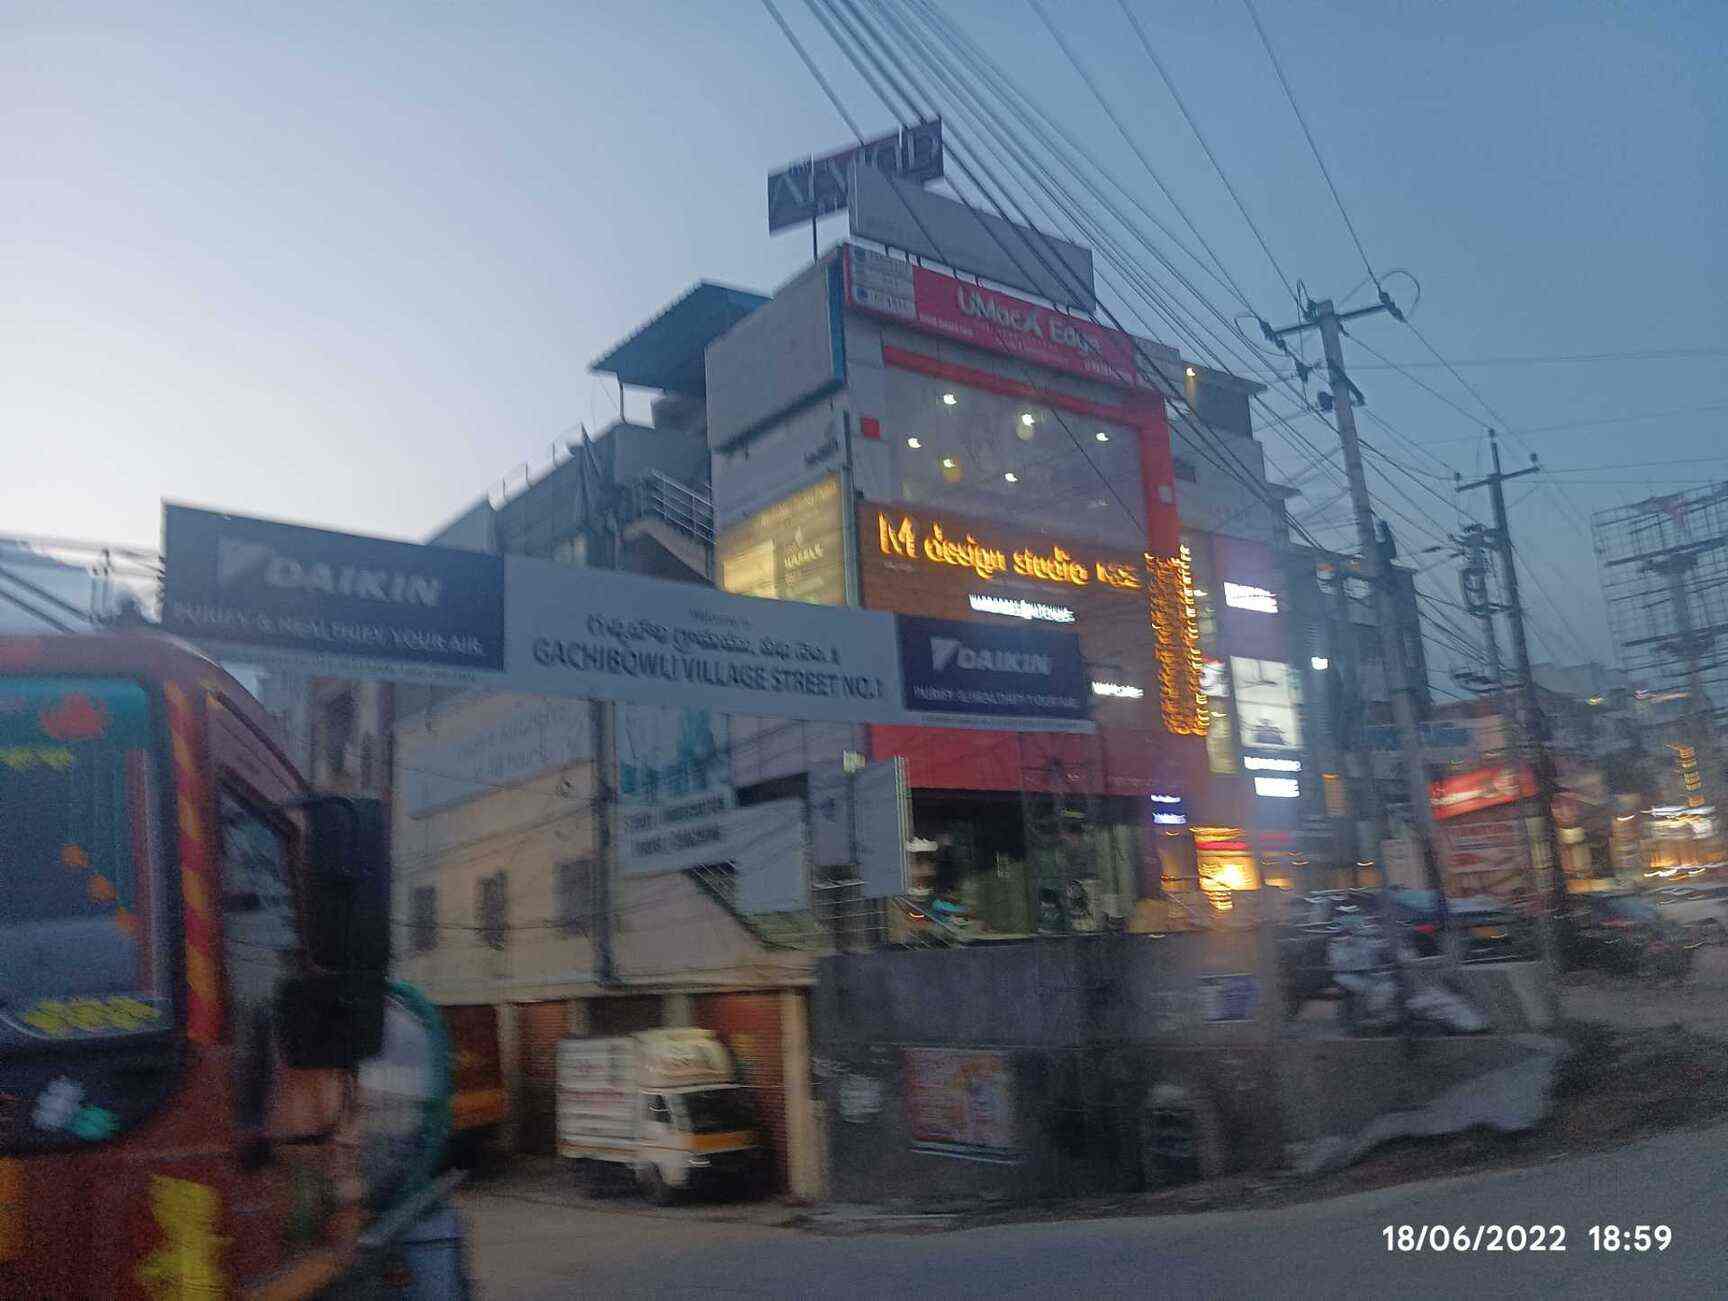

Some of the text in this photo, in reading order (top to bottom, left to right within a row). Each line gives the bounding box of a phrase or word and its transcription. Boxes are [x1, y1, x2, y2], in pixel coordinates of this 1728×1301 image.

[923, 519, 1007, 580] design
[1013, 545, 1089, 586] studio
[264, 555, 442, 608] DAIKIN
[682, 656, 768, 692] VILLAGE
[770, 667, 841, 697] STREET
[956, 649, 1051, 676] DAIKIN
